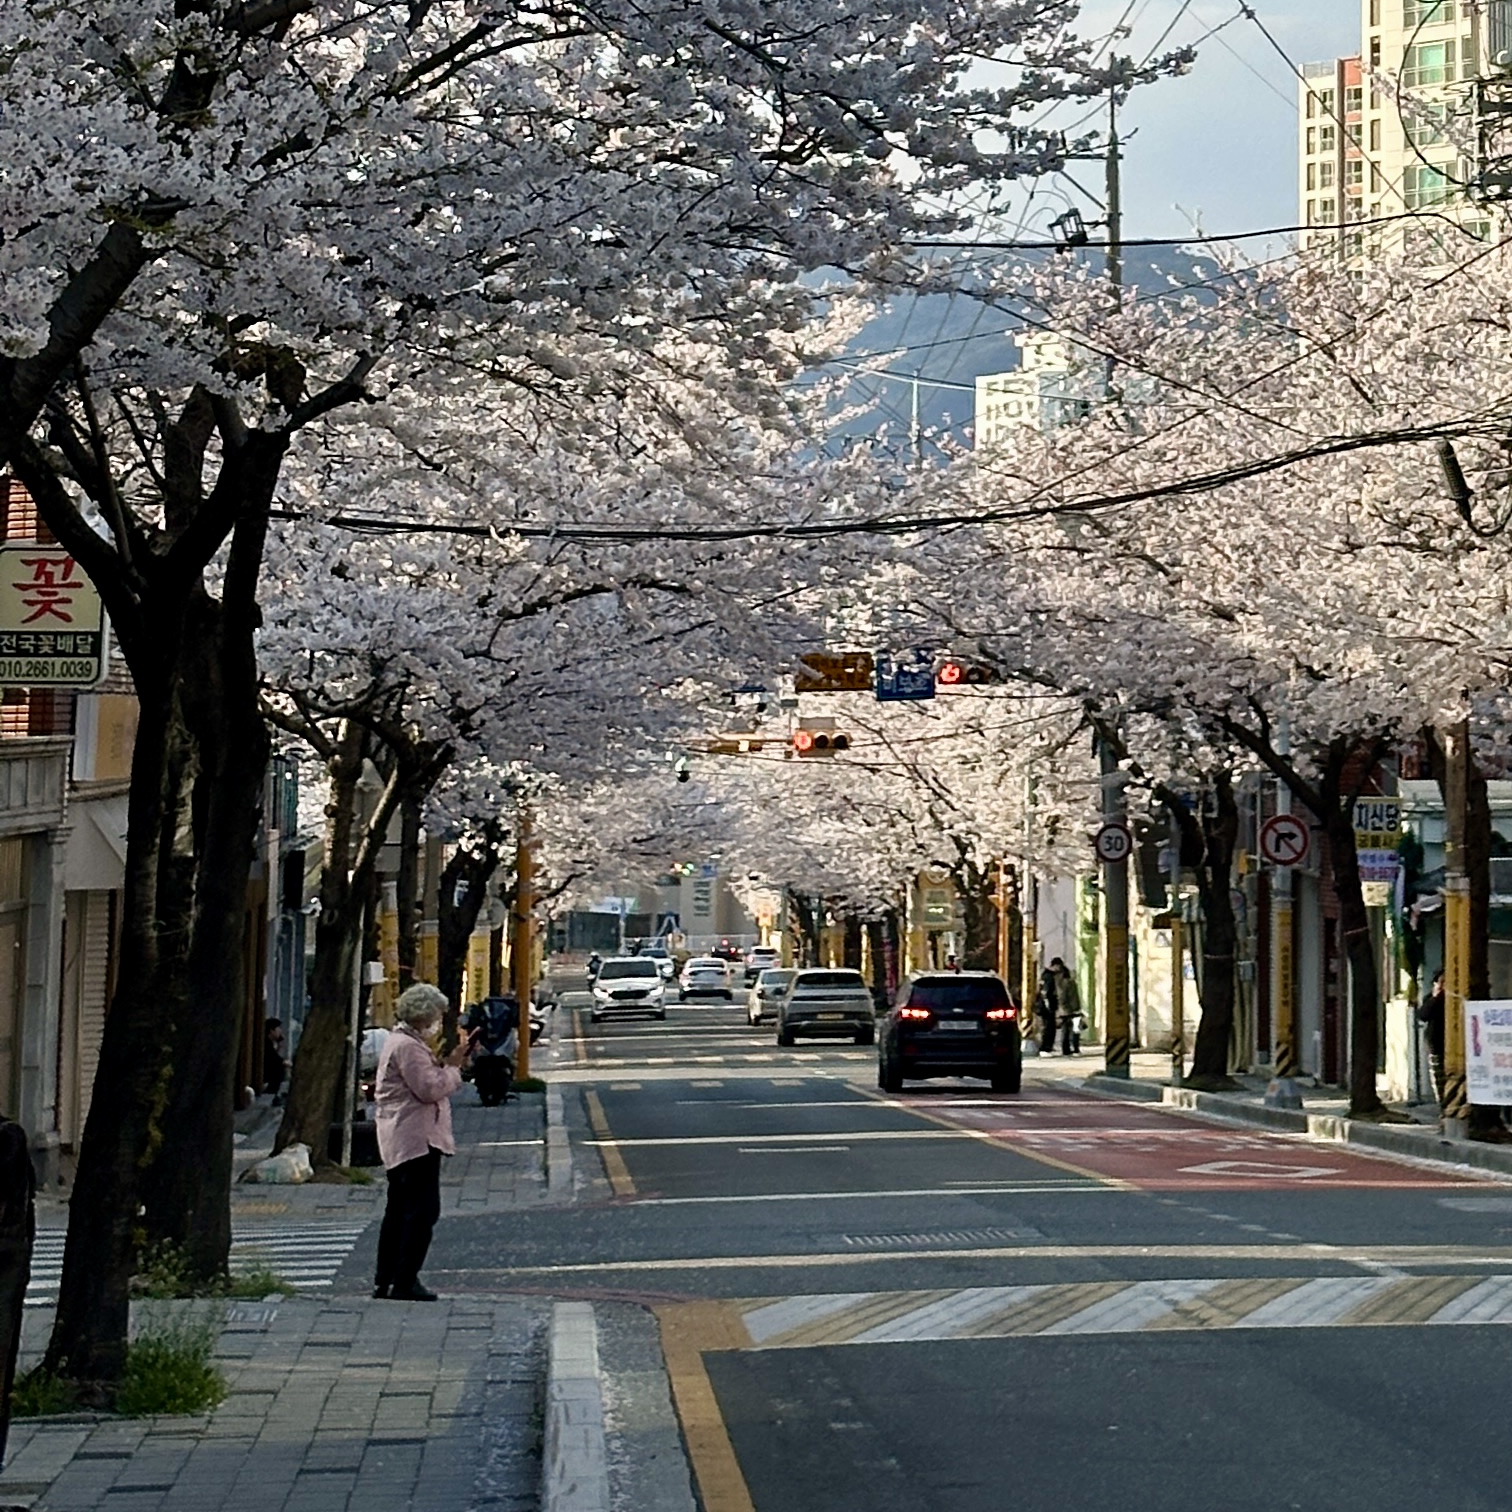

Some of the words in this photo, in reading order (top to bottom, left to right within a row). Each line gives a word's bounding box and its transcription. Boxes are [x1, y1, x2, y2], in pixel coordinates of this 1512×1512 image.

[12, 555, 84, 624] 꽃
[0, 634, 94, 654] 전국꽃배달
[1103, 835, 1125, 852] 30
